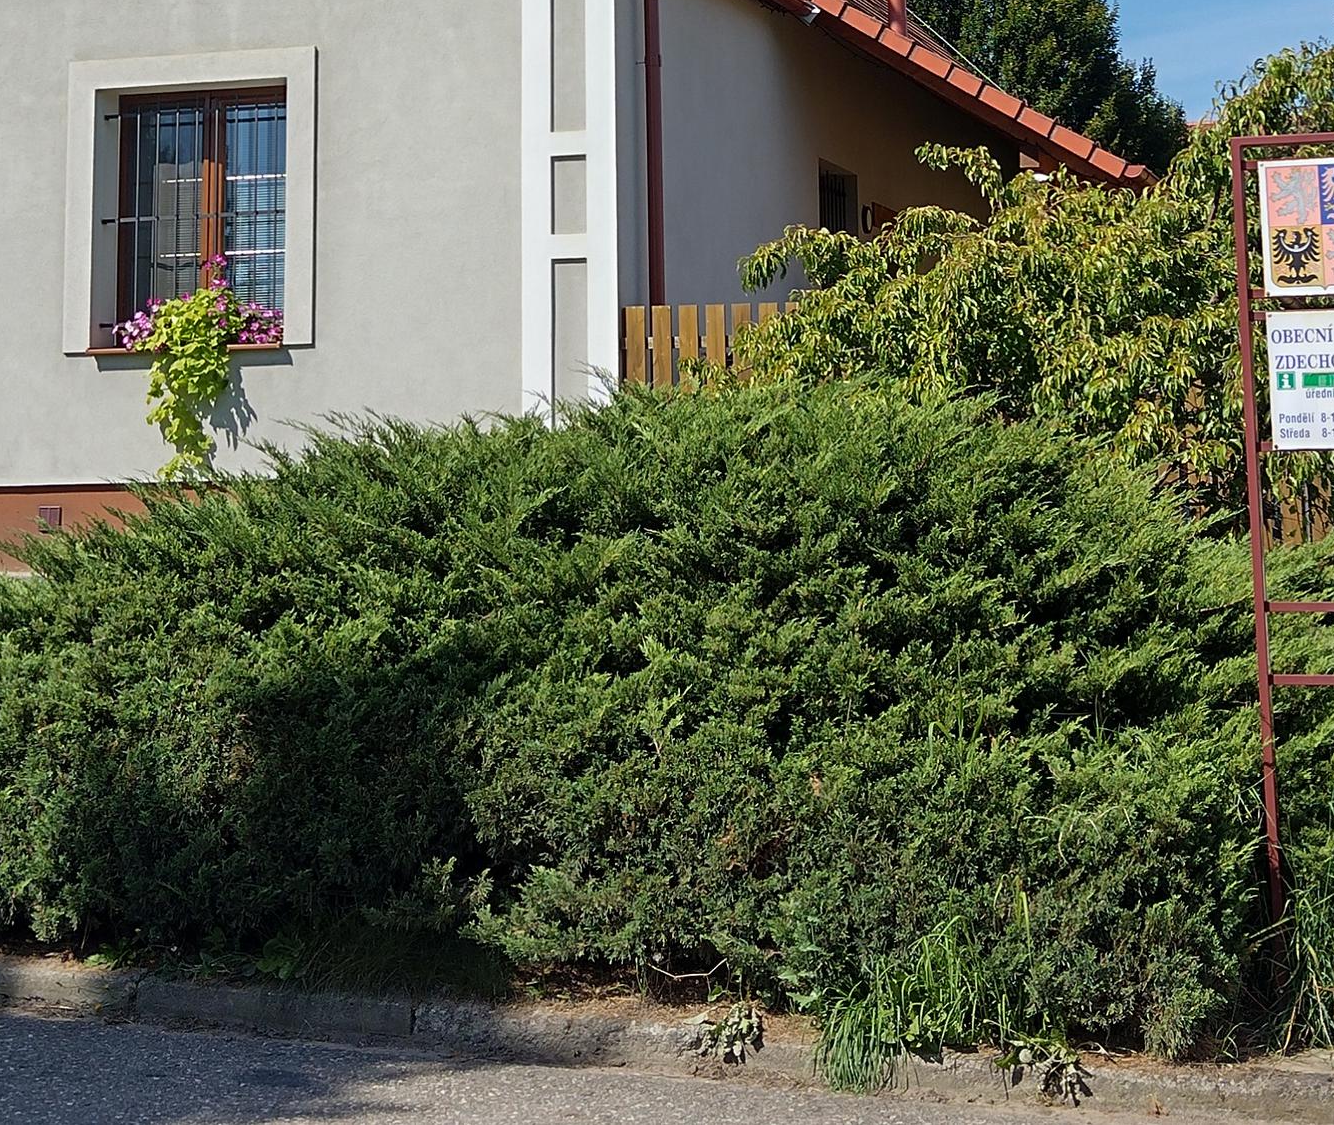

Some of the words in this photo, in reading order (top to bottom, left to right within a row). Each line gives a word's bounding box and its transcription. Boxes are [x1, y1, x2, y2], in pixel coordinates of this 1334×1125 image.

[1271, 324, 1333, 344] OBECNÍ
[1279, 412, 1315, 424] Pondělí
[1280, 428, 1311, 439] Středa
